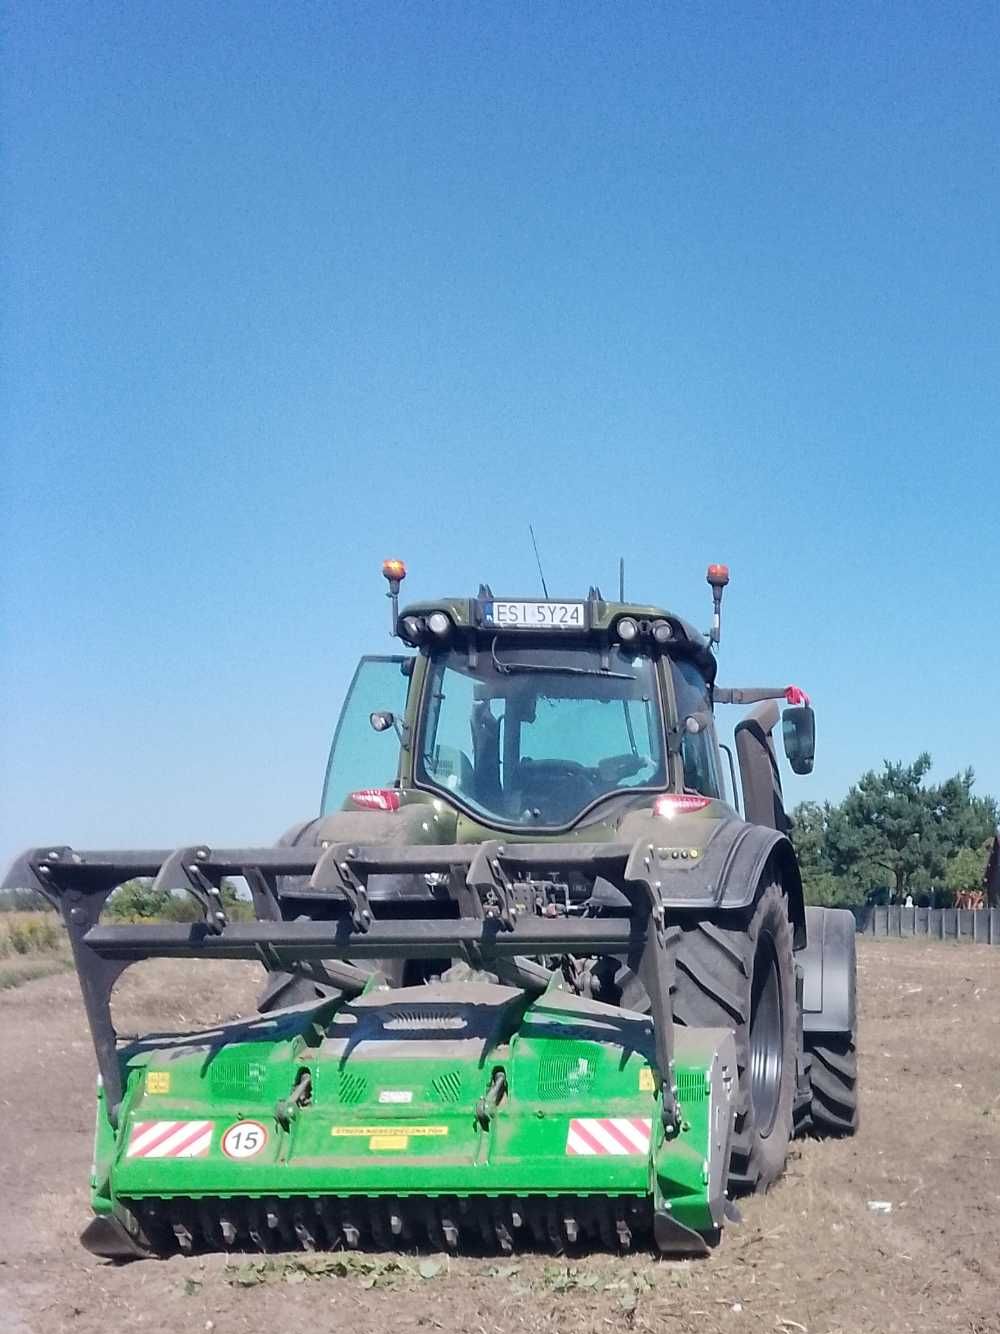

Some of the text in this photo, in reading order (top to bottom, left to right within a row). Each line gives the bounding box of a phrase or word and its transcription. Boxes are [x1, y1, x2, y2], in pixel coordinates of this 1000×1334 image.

[497, 604, 526, 622] ESI
[537, 605, 579, 624] 5Y24
[232, 1131, 259, 1150] 15
